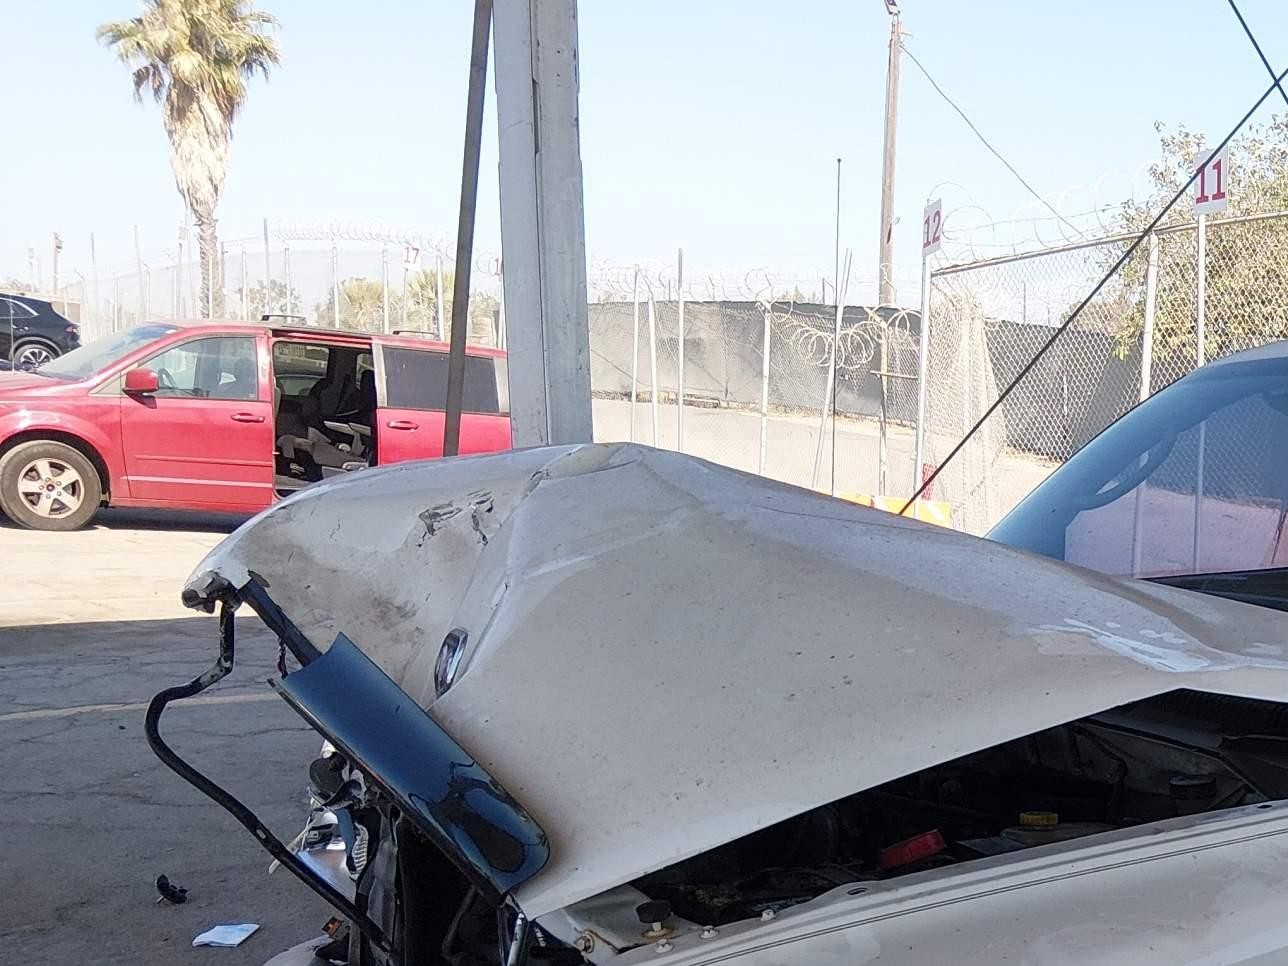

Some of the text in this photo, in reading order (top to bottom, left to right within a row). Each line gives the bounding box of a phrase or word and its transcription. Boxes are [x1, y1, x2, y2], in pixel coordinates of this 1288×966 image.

[1195, 158, 1226, 204] 11
[923, 209, 942, 249] 12
[404, 247, 420, 264] 17
